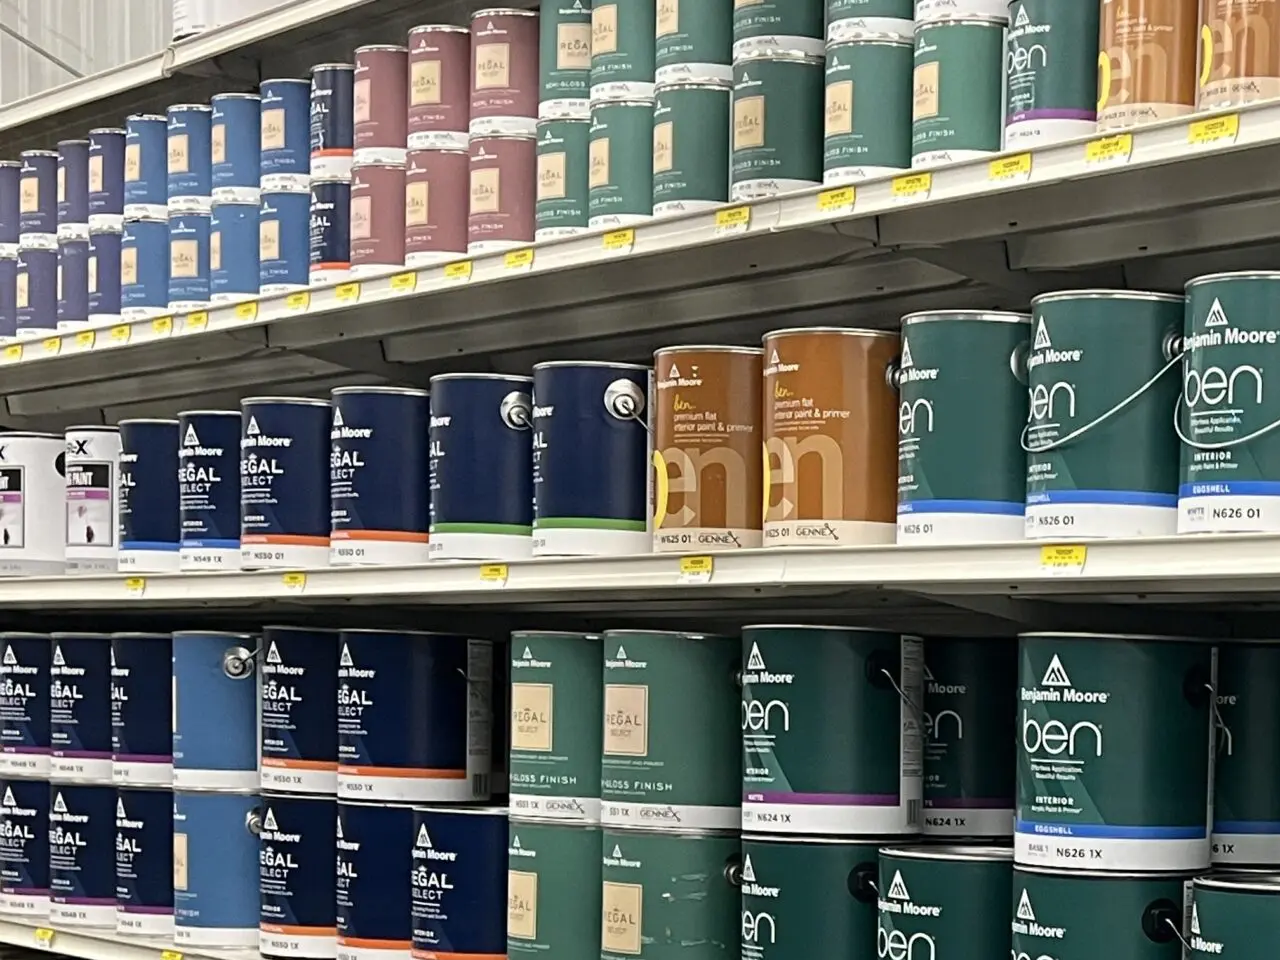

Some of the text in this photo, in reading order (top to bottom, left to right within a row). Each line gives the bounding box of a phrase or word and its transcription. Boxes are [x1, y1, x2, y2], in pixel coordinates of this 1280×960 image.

[1213, 508, 1242, 519] N626
[1021, 687, 1107, 703] Benjamin Moore
[635, 781, 672, 791] FINISH
[1057, 848, 1102, 859] N626 1X
